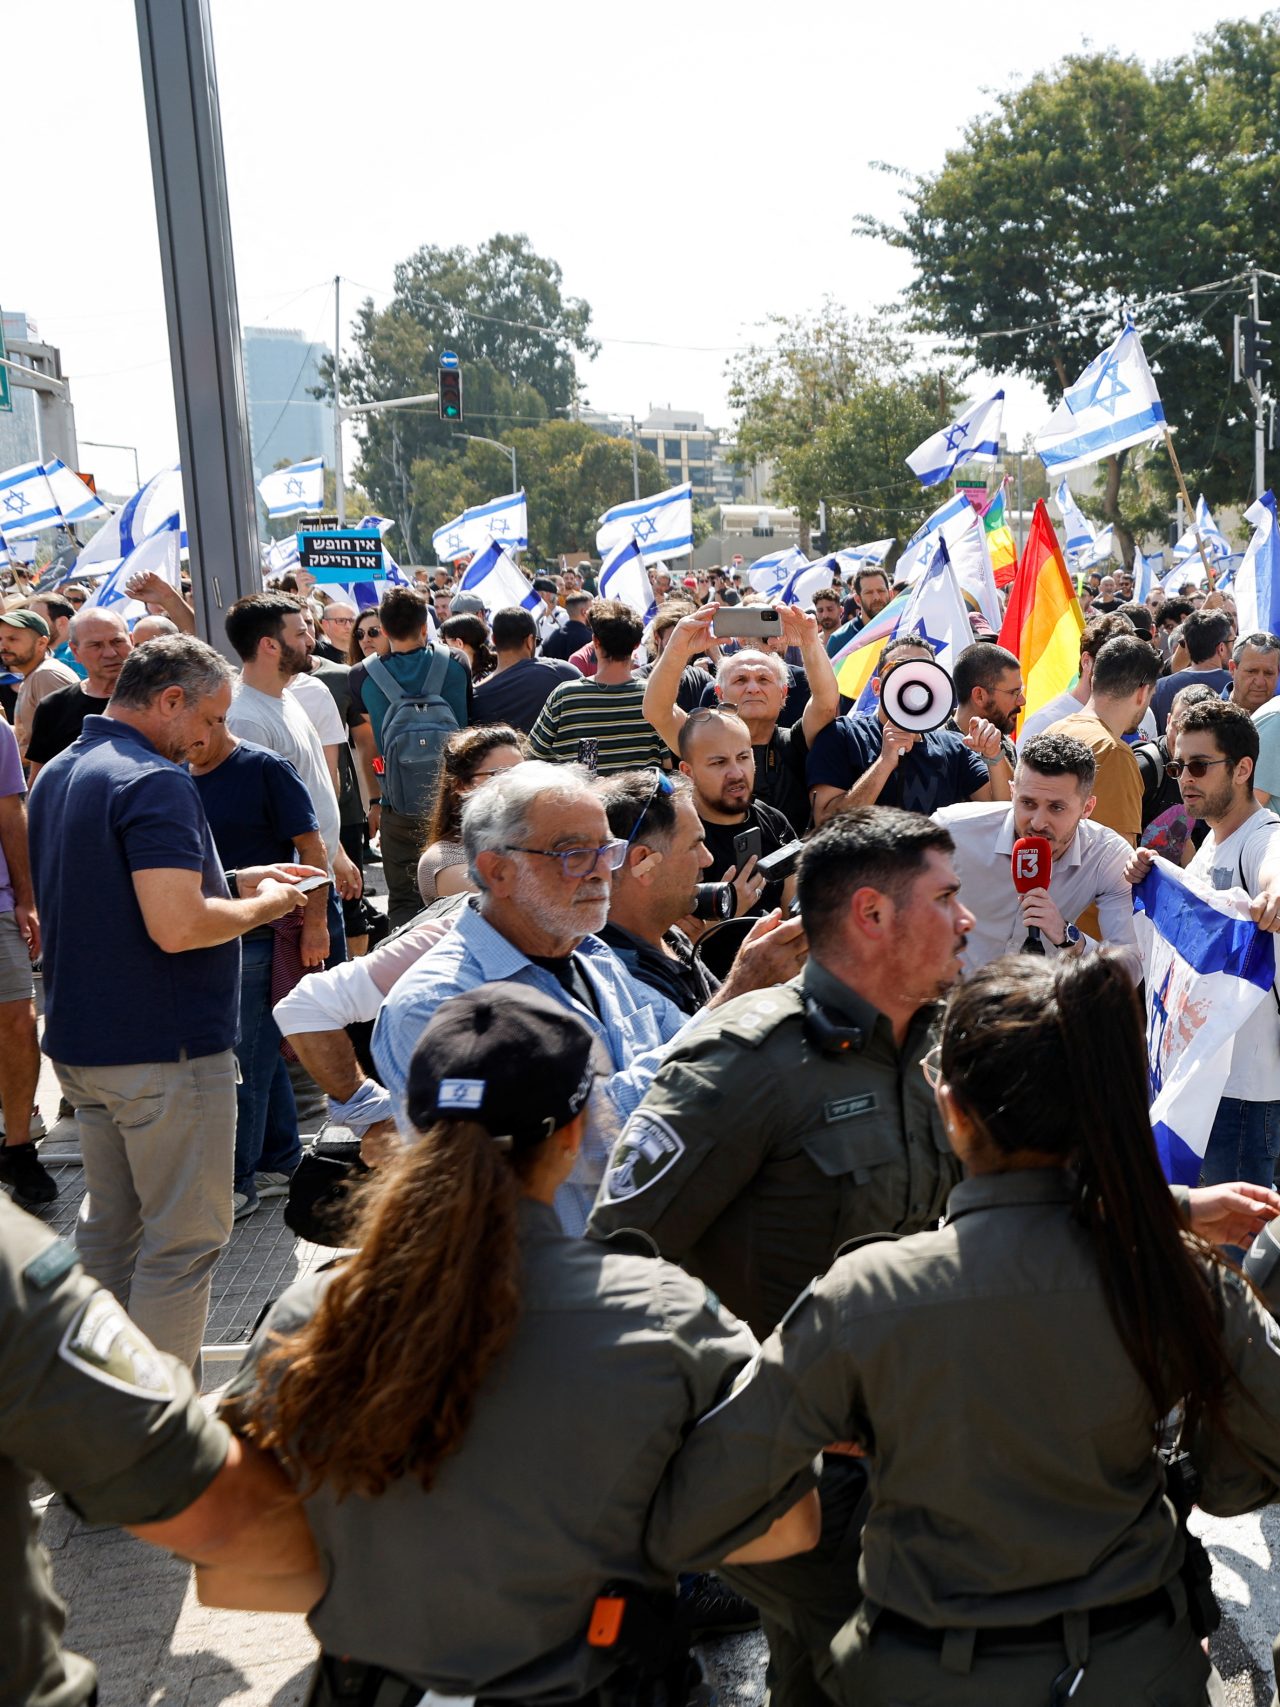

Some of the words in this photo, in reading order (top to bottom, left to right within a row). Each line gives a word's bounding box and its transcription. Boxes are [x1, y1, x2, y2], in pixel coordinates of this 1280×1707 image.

[312, 538, 351, 551] חופש
[354, 539, 376, 552] אין
[309, 554, 352, 567] הייטק
[354, 555, 376, 568] אין
[1016, 854, 1039, 879] 13
